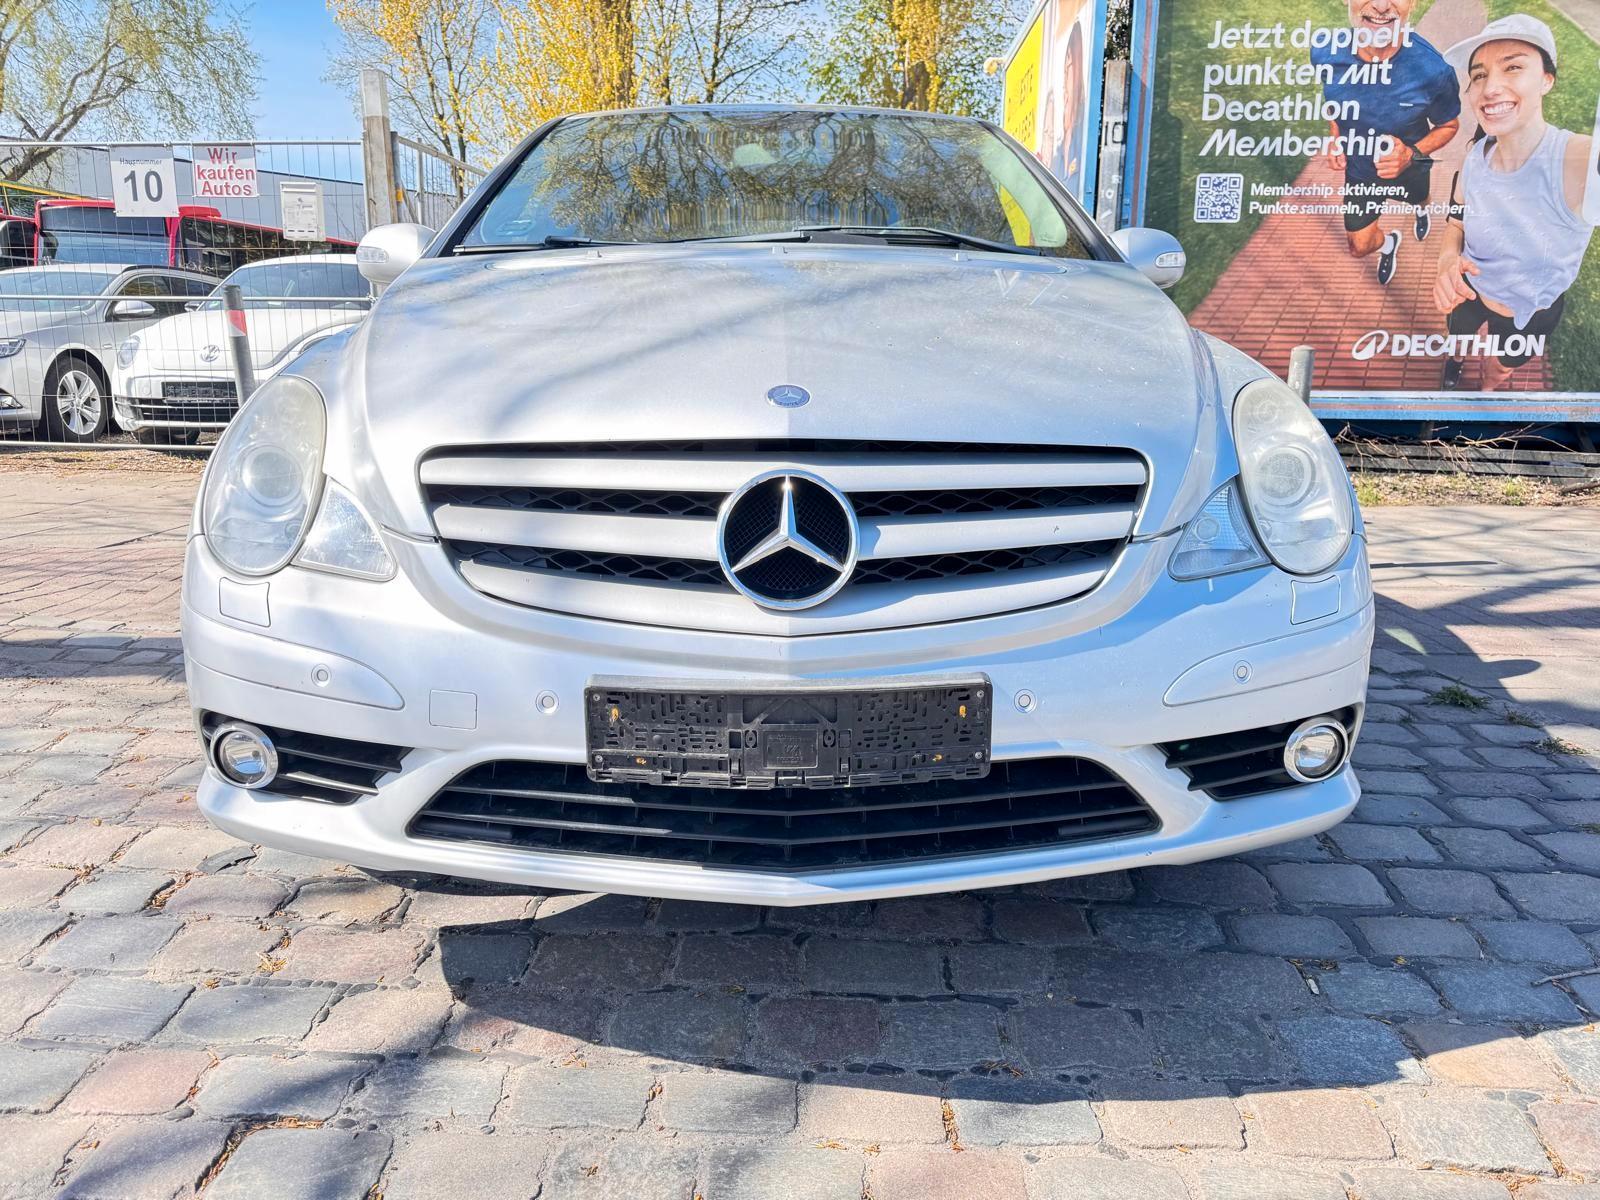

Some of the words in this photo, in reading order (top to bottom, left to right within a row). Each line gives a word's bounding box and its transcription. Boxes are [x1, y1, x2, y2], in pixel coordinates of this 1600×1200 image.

[1207, 20, 1285, 49] Jetzt
[1290, 19, 1415, 54] doppelt
[1203, 56, 1334, 91] punkten
[1201, 93, 1361, 121] Decathlon
[207, 147, 238, 165] Wir
[1199, 128, 1396, 163] Membership
[197, 165, 255, 180] kaufen
[124, 170, 163, 203] 10
[201, 181, 252, 196] Autos
[1250, 183, 1333, 198] Membership
[1338, 183, 1409, 198] aktivieren,
[1249, 202, 1297, 215] Punkte
[1299, 202, 1364, 216] sammeln,
[1365, 201, 1422, 215] Prämien
[1424, 202, 1474, 215] sichern.
[1391, 334, 1546, 357] DECATHLON
